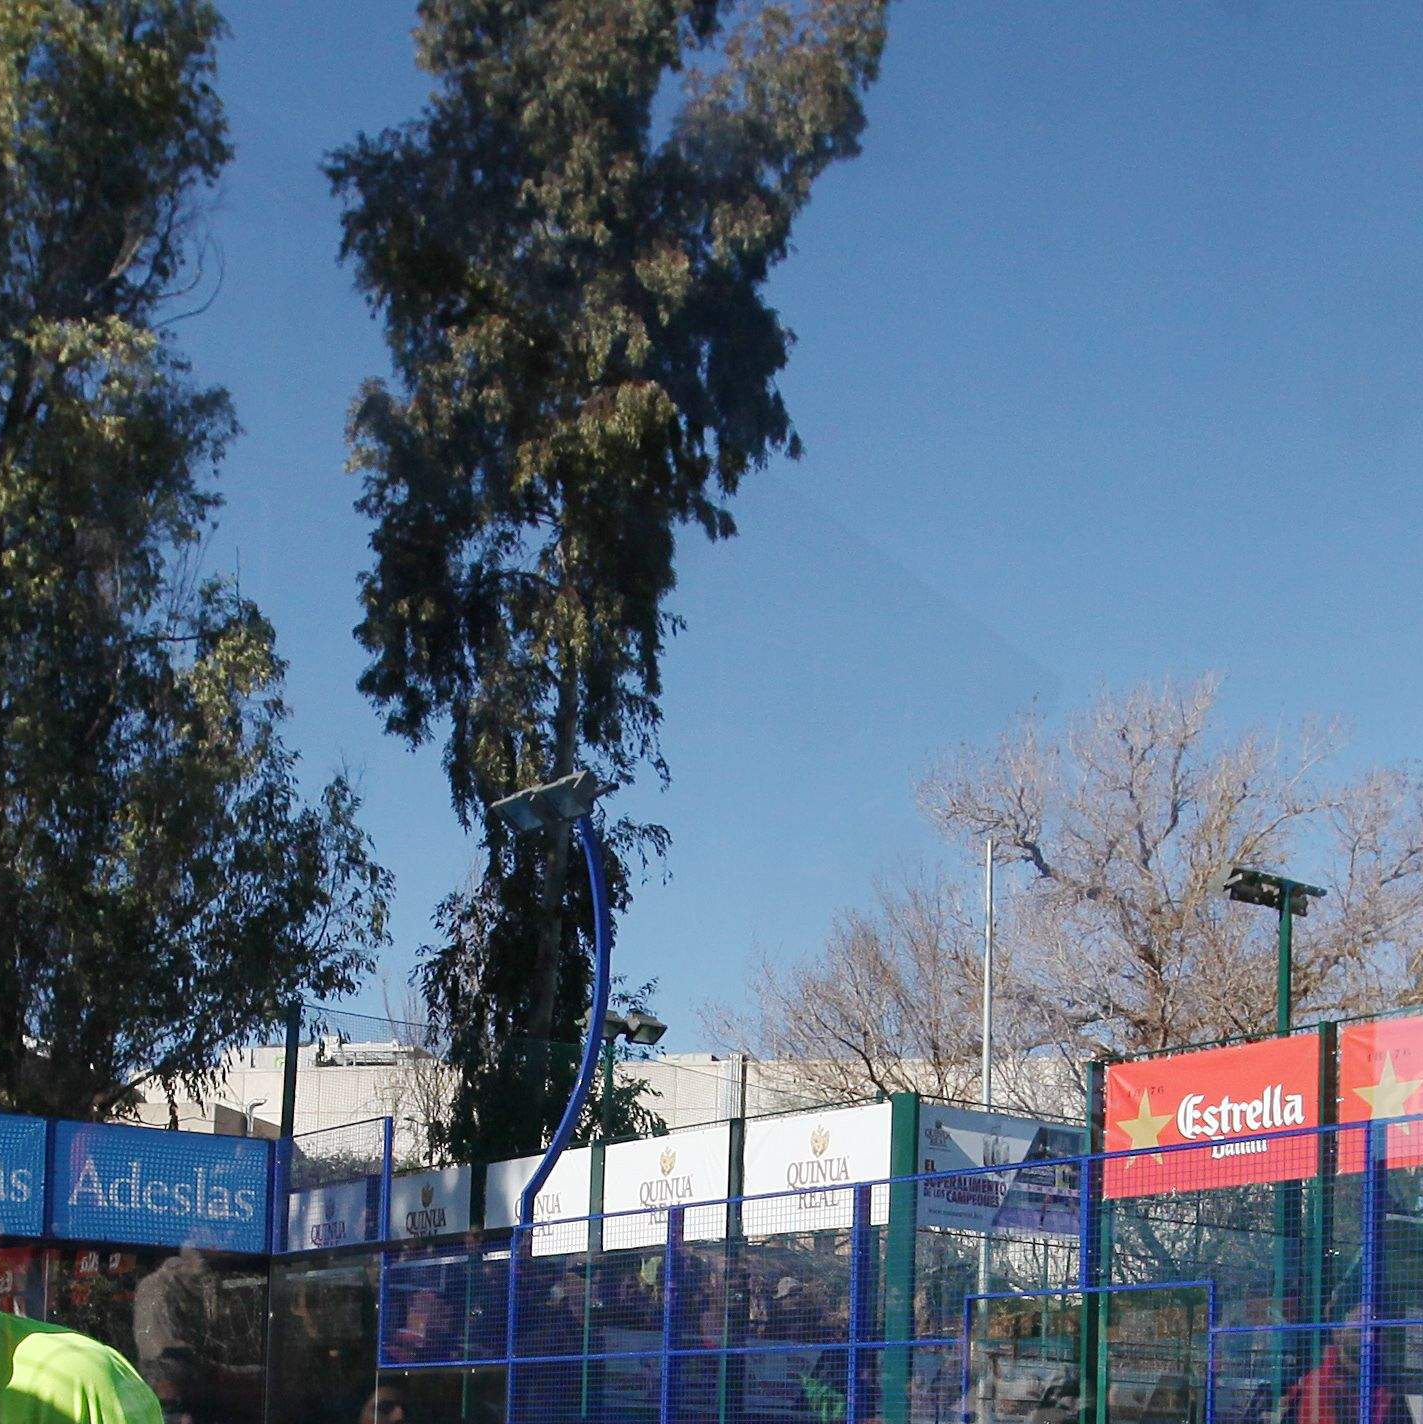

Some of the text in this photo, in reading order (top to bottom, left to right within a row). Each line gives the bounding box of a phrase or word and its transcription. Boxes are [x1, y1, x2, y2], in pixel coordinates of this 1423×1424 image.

[1177, 1083, 1305, 1140] Estrella
[787, 1157, 850, 1189] QUINUA
[68, 1159, 254, 1221] Adeslas
[640, 1175, 693, 1205] QUINUA
[798, 1188, 839, 1210] REAL
[310, 1221, 346, 1245] QUINUA
[405, 1207, 447, 1232] QUINUA
